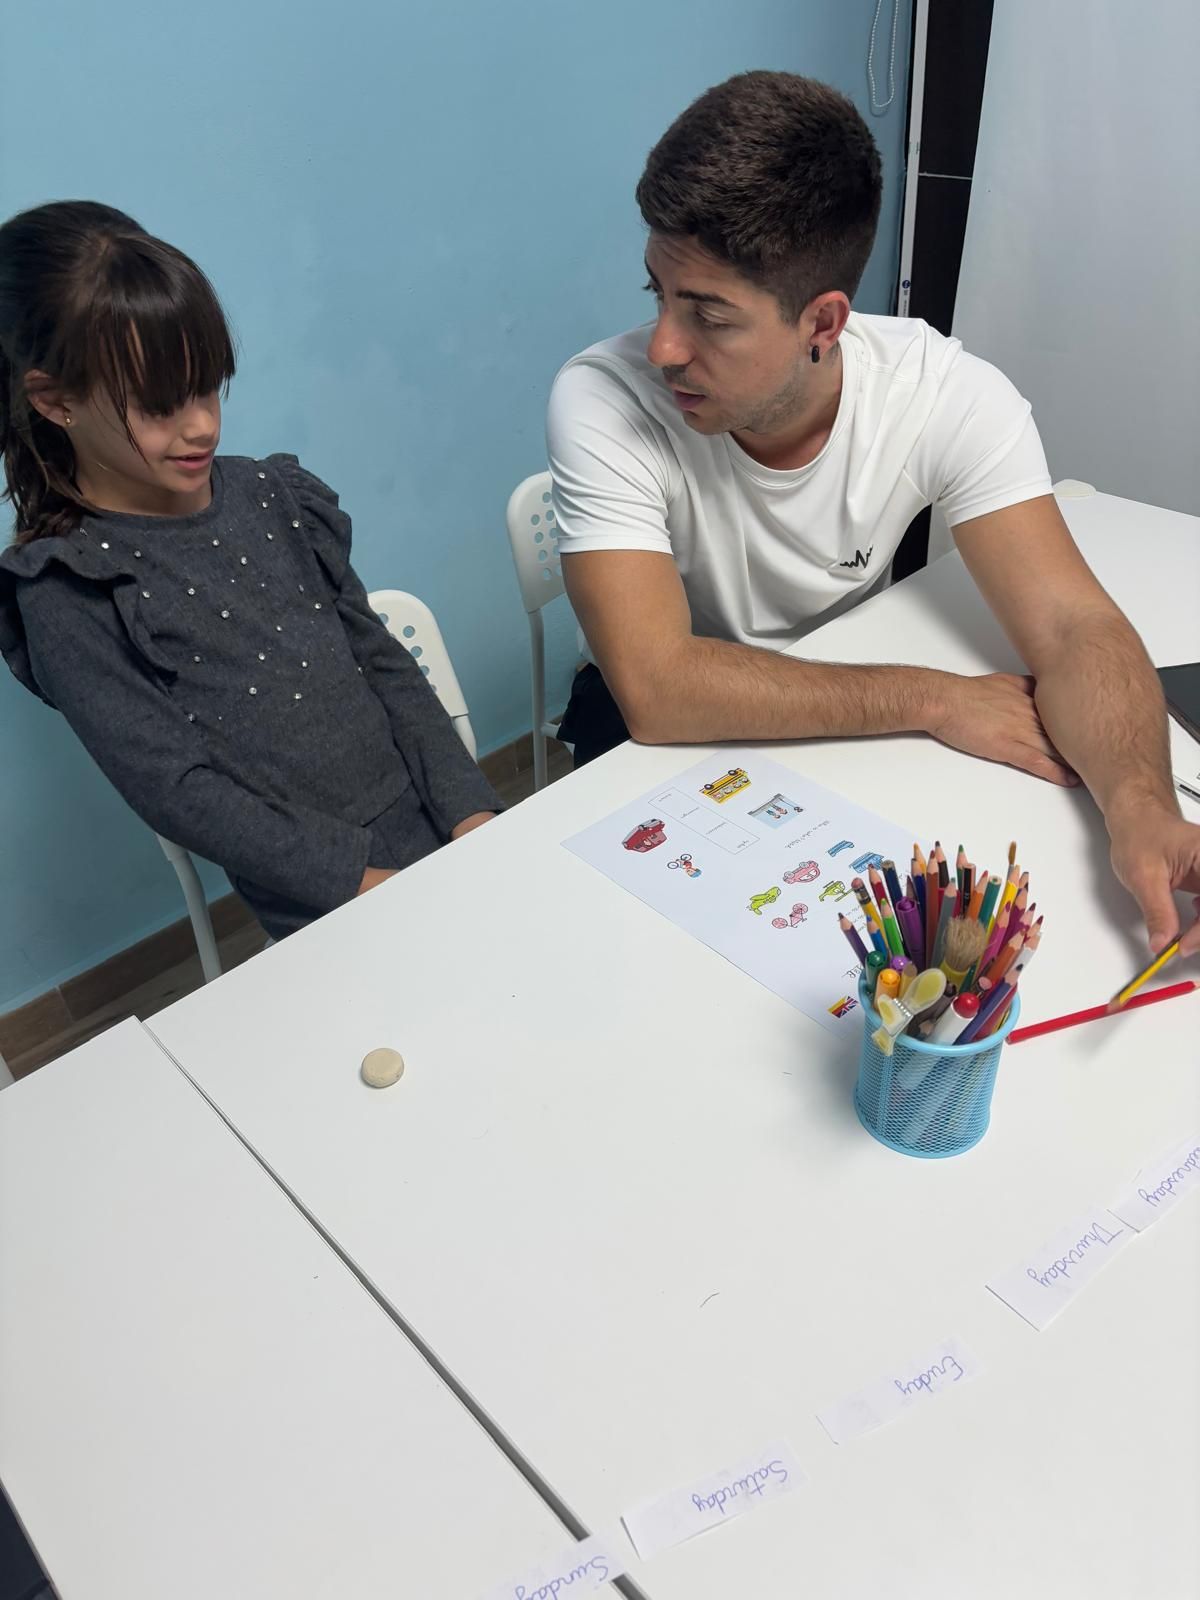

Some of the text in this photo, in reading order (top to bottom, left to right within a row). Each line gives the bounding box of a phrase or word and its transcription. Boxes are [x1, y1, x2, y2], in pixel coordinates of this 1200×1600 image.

[1137, 1146, 1200, 1207] ednesday
[1027, 1222, 1124, 1288] Thursday
[894, 1355, 964, 1395] Friday
[691, 1460, 789, 1514] Saturday
[514, 1555, 609, 1600] Sunday
